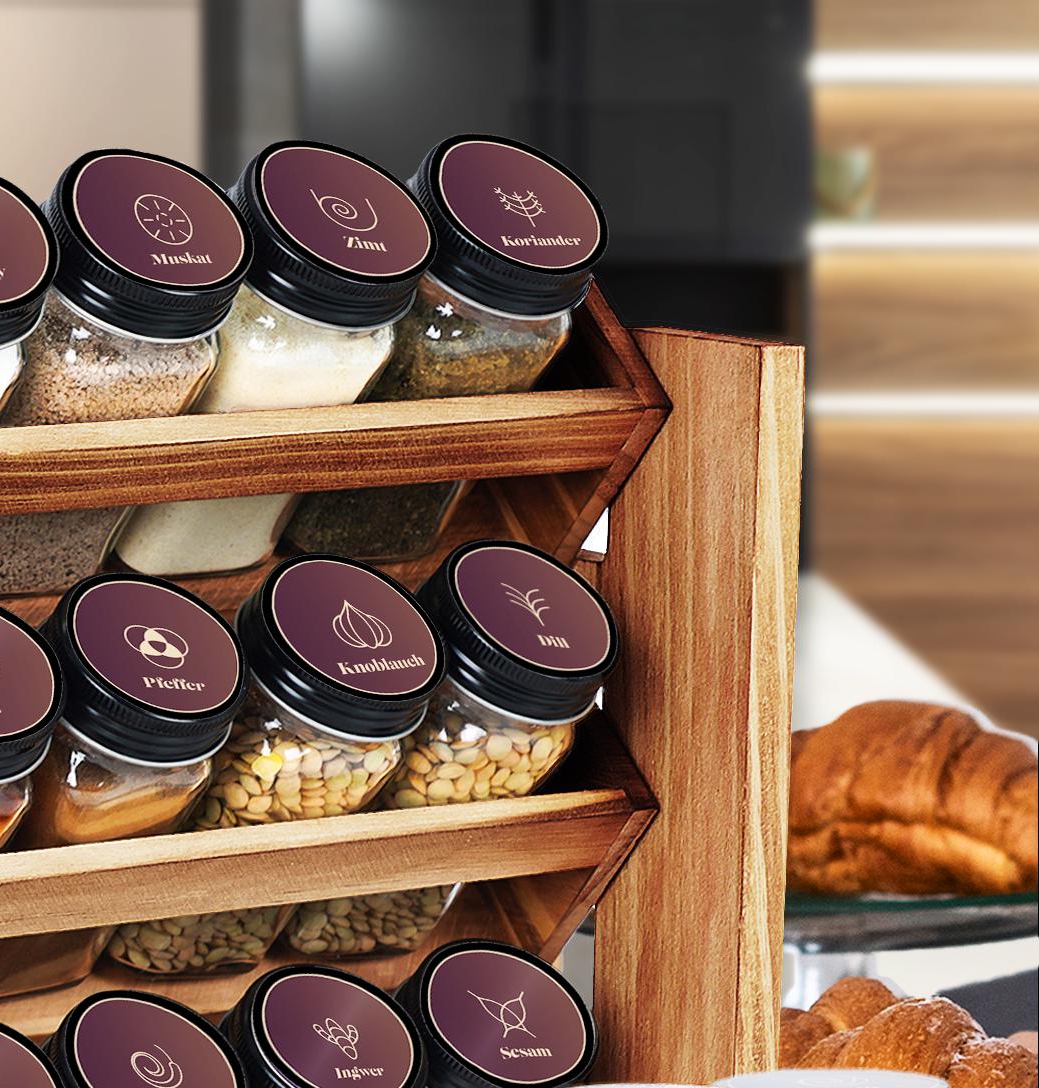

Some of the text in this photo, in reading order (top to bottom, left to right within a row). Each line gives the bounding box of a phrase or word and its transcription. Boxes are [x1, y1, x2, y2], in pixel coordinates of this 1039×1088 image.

[342, 235, 388, 252] Zimt
[500, 235, 582, 248] Koriander
[150, 251, 213, 265] Muskat
[536, 633, 571, 649] Dill
[337, 653, 426, 675] Knoblauch
[142, 675, 206, 692] Pfeffer
[499, 1046, 553, 1060] Sesam
[334, 1066, 385, 1081] Ingwer
